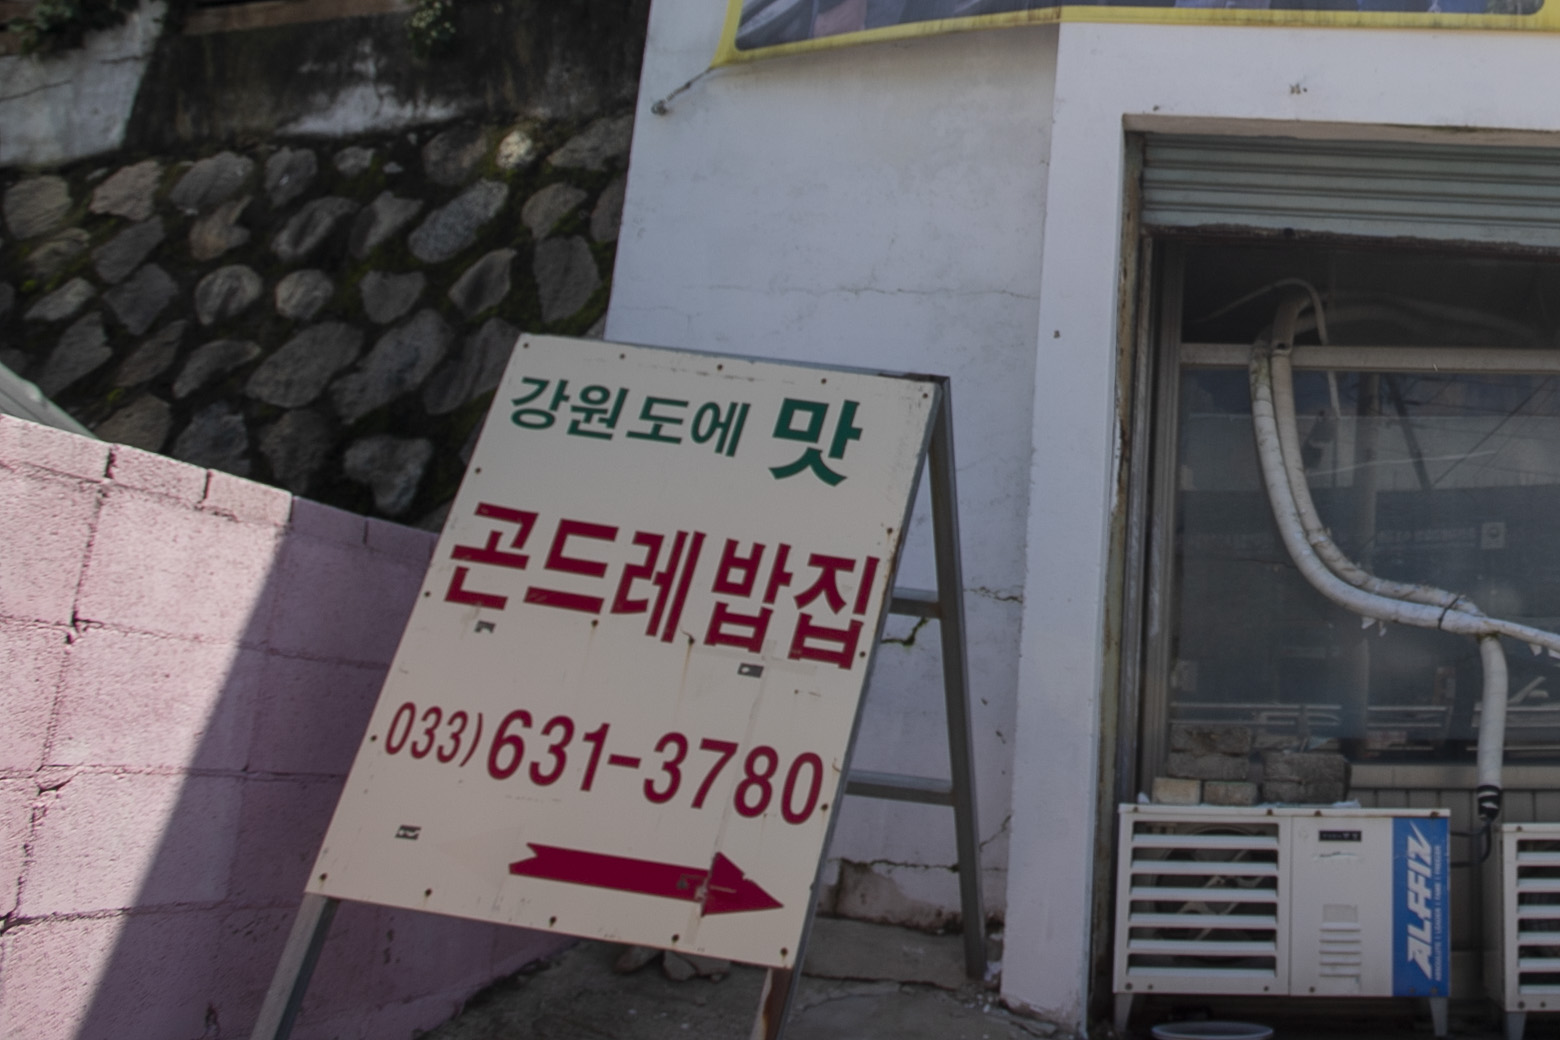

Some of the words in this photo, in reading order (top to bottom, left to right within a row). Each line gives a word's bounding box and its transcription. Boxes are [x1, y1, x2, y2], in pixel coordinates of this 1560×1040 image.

[510, 376, 750, 457] 강원도에
[768, 397, 863, 487] 맛
[444, 502, 880, 670] 곤드레밥집
[385, 702, 824, 825] 033)631-3780
